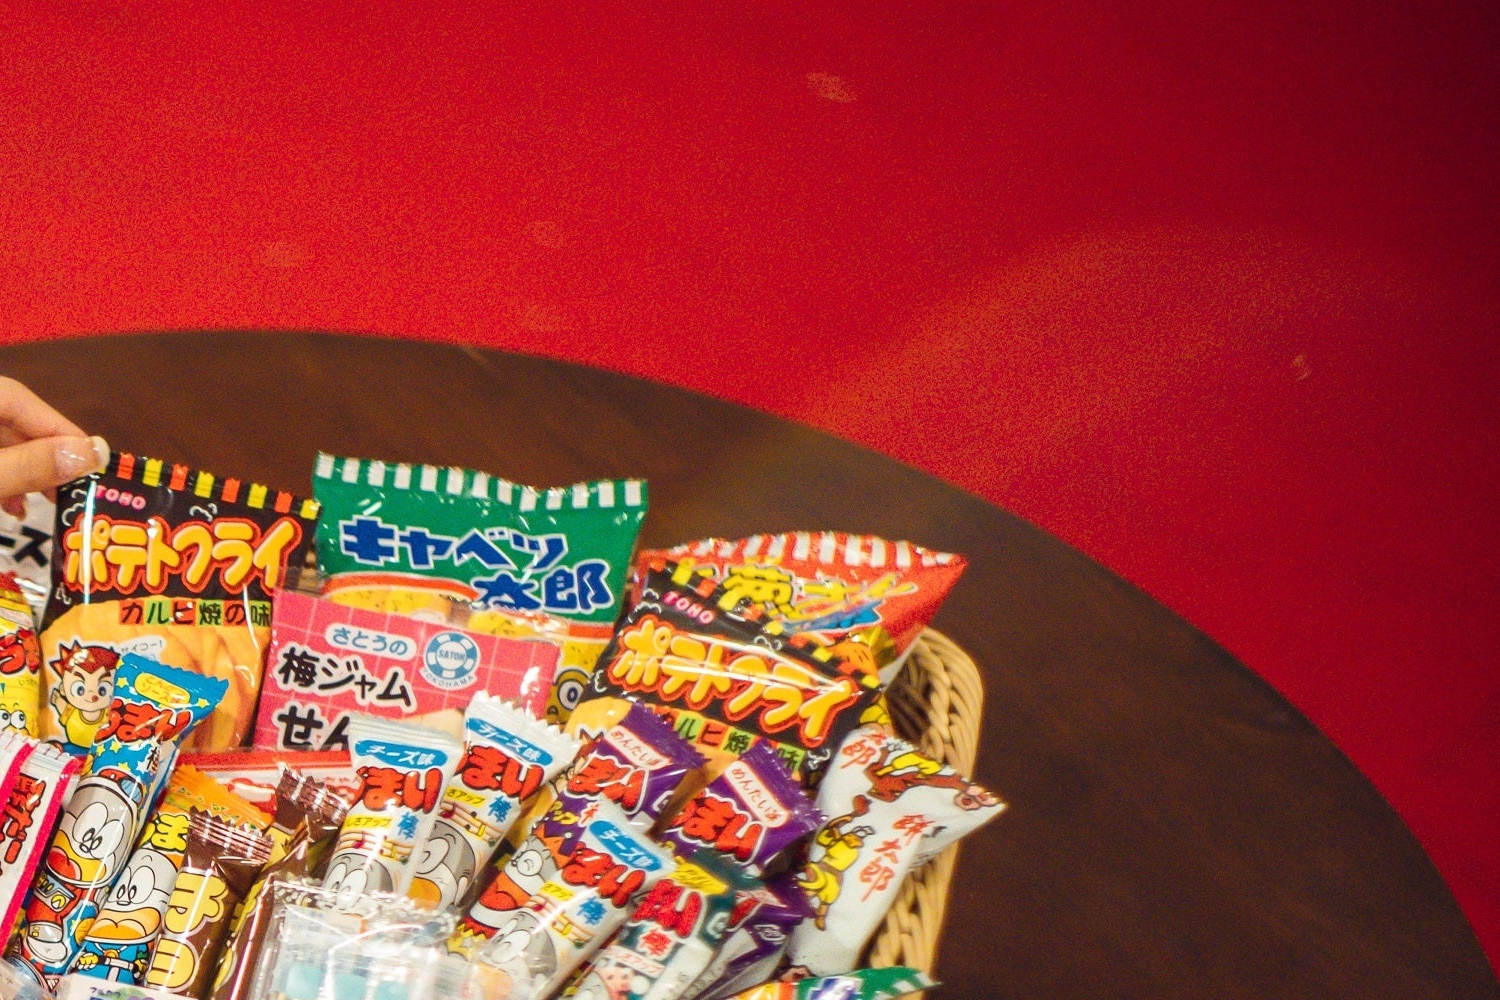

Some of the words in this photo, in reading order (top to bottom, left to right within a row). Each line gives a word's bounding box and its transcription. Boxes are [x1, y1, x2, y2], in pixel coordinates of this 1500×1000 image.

[63, 515, 300, 594] ポテトフライ
[341, 516, 566, 570] キャベツ
[475, 563, 610, 611] 太郎
[663, 591, 714, 624] TOHO
[332, 625, 409, 656] さとうの
[278, 645, 412, 707] 梅ジャム
[610, 616, 856, 746] ポテトフライ
[366, 745, 436, 766] チーズ味
[478, 724, 542, 762] チーズ味
[350, 766, 443, 814] まい
[454, 744, 545, 803] まい
